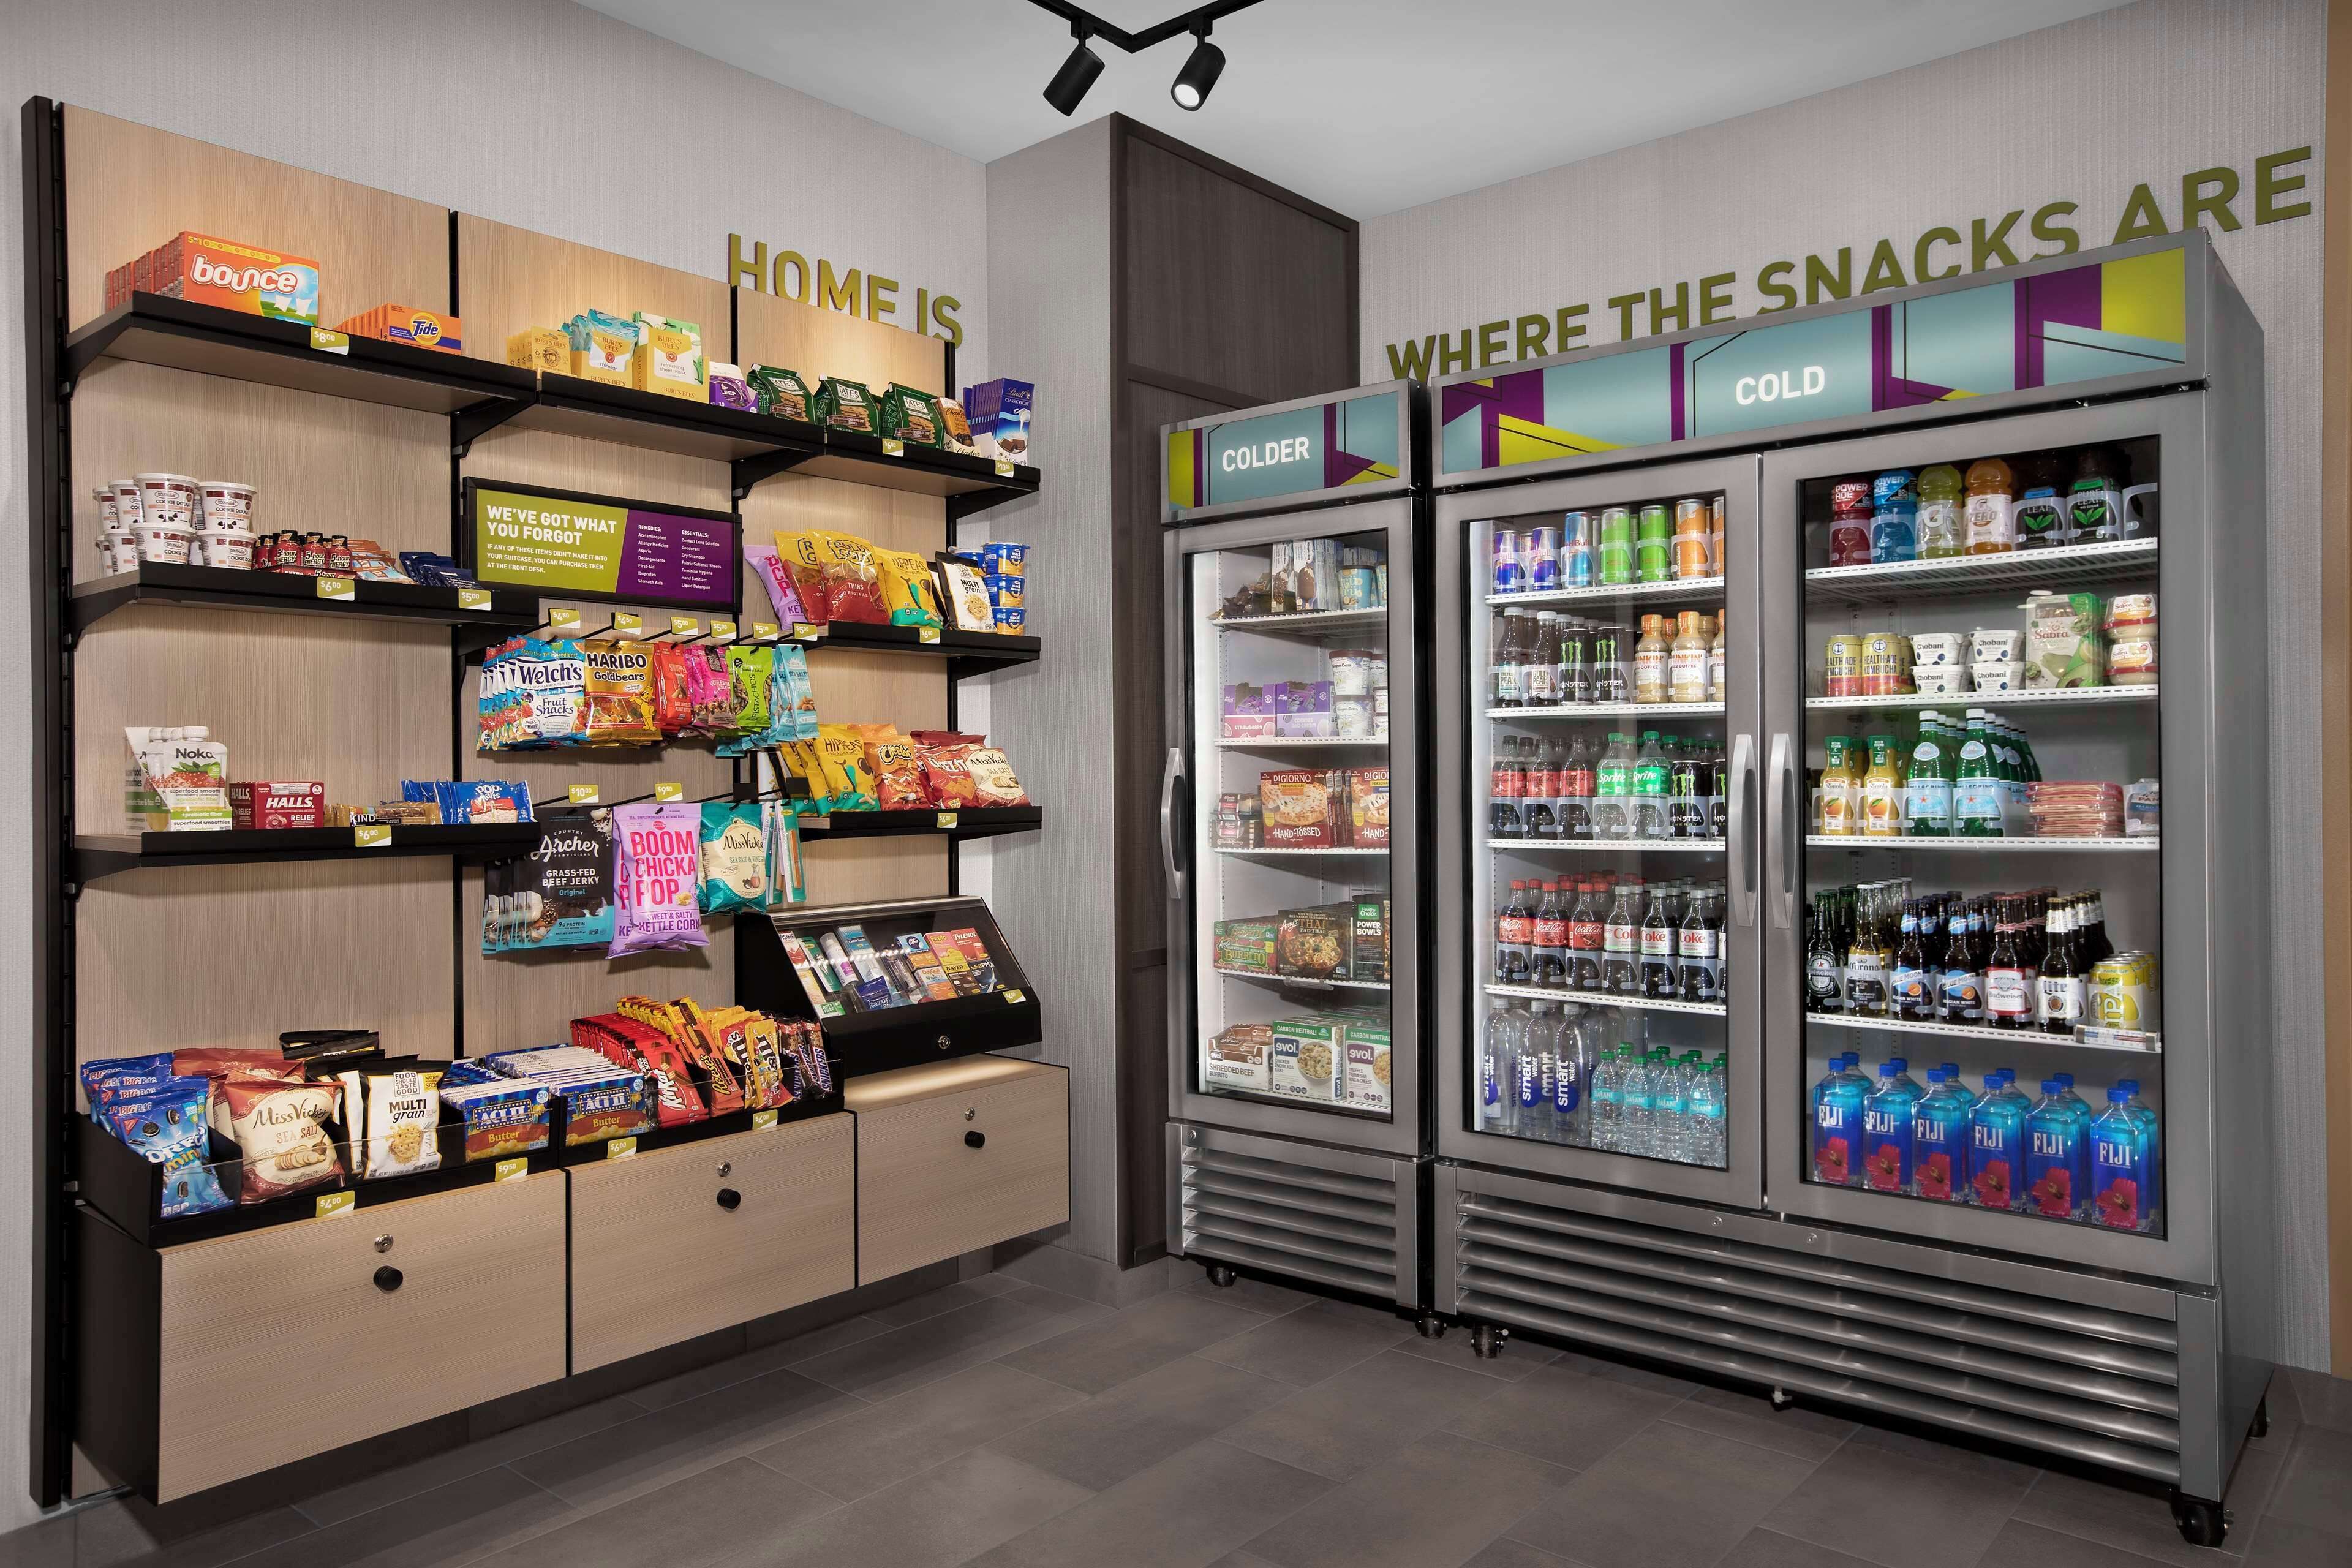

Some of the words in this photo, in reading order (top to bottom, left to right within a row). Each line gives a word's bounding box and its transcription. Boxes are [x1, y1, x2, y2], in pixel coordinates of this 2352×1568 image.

[1386, 303, 1589, 385] WHERE
[1608, 271, 1736, 341] THE
[1757, 201, 2081, 315] SNACKS
[2112, 145, 2312, 246] ARE
[190, 254, 298, 293] bounce
[728, 233, 899, 328] HOME
[917, 288, 963, 349] IS
[412, 320, 439, 336] Tide
[658, 335, 682, 344] BURT'S
[662, 341, 679, 350] BEES
[663, 386, 681, 395] BURT'S
[1008, 387, 1025, 398] Lindt
[1735, 366, 1825, 406] COLD
[905, 396, 925, 410] TATE'S
[1222, 437, 1310, 472] COLDER
[487, 505, 537, 524] WE'VE
[541, 513, 570, 527] GOT
[574, 516, 617, 534] WHAT
[487, 522, 519, 538] YOU
[523, 526, 582, 545] FORGOT
[960, 579, 980, 588] MULTI
[587, 654, 647, 669] HARIBO
[518, 663, 582, 684] Welch's
[594, 671, 645, 682] Goldbears
[535, 705, 574, 717] Snacks
[825, 738, 862, 752] HIPPEAS
[176, 748, 216, 760] Noka
[1634, 771, 1657, 782] Sprite
[350, 813, 375, 823] KIND
[1273, 827, 1321, 839] HAND-TOSSED
[530, 835, 599, 863] Archer
[630, 831, 695, 857] BOOM
[546, 869, 596, 878] GRASS-FED
[635, 857, 696, 878] CHICKA
[542, 878, 567, 887] BEEF
[570, 875, 600, 885] JERKY
[636, 879, 679, 907] POP
[639, 921, 674, 932] KETTLE
[677, 919, 699, 930] CORN
[1300, 920, 1325, 929] THAI
[953, 932, 977, 941] TYLENOL
[1641, 930, 1666, 941] Coke
[813, 1047, 832, 1091] SNICKERS
[1209, 1063, 1239, 1074] SHREDDED
[1558, 1060, 1569, 1106] smart
[388, 1099, 427, 1114] MULTI
[393, 1110, 425, 1123] grain
[480, 1107, 505, 1125] ACT
[1819, 1104, 1842, 1126] FIJI
[488, 1130, 520, 1143] Butter
[1917, 1119, 1944, 1140] FIJI
[2099, 1142, 2130, 1166] FIJI
